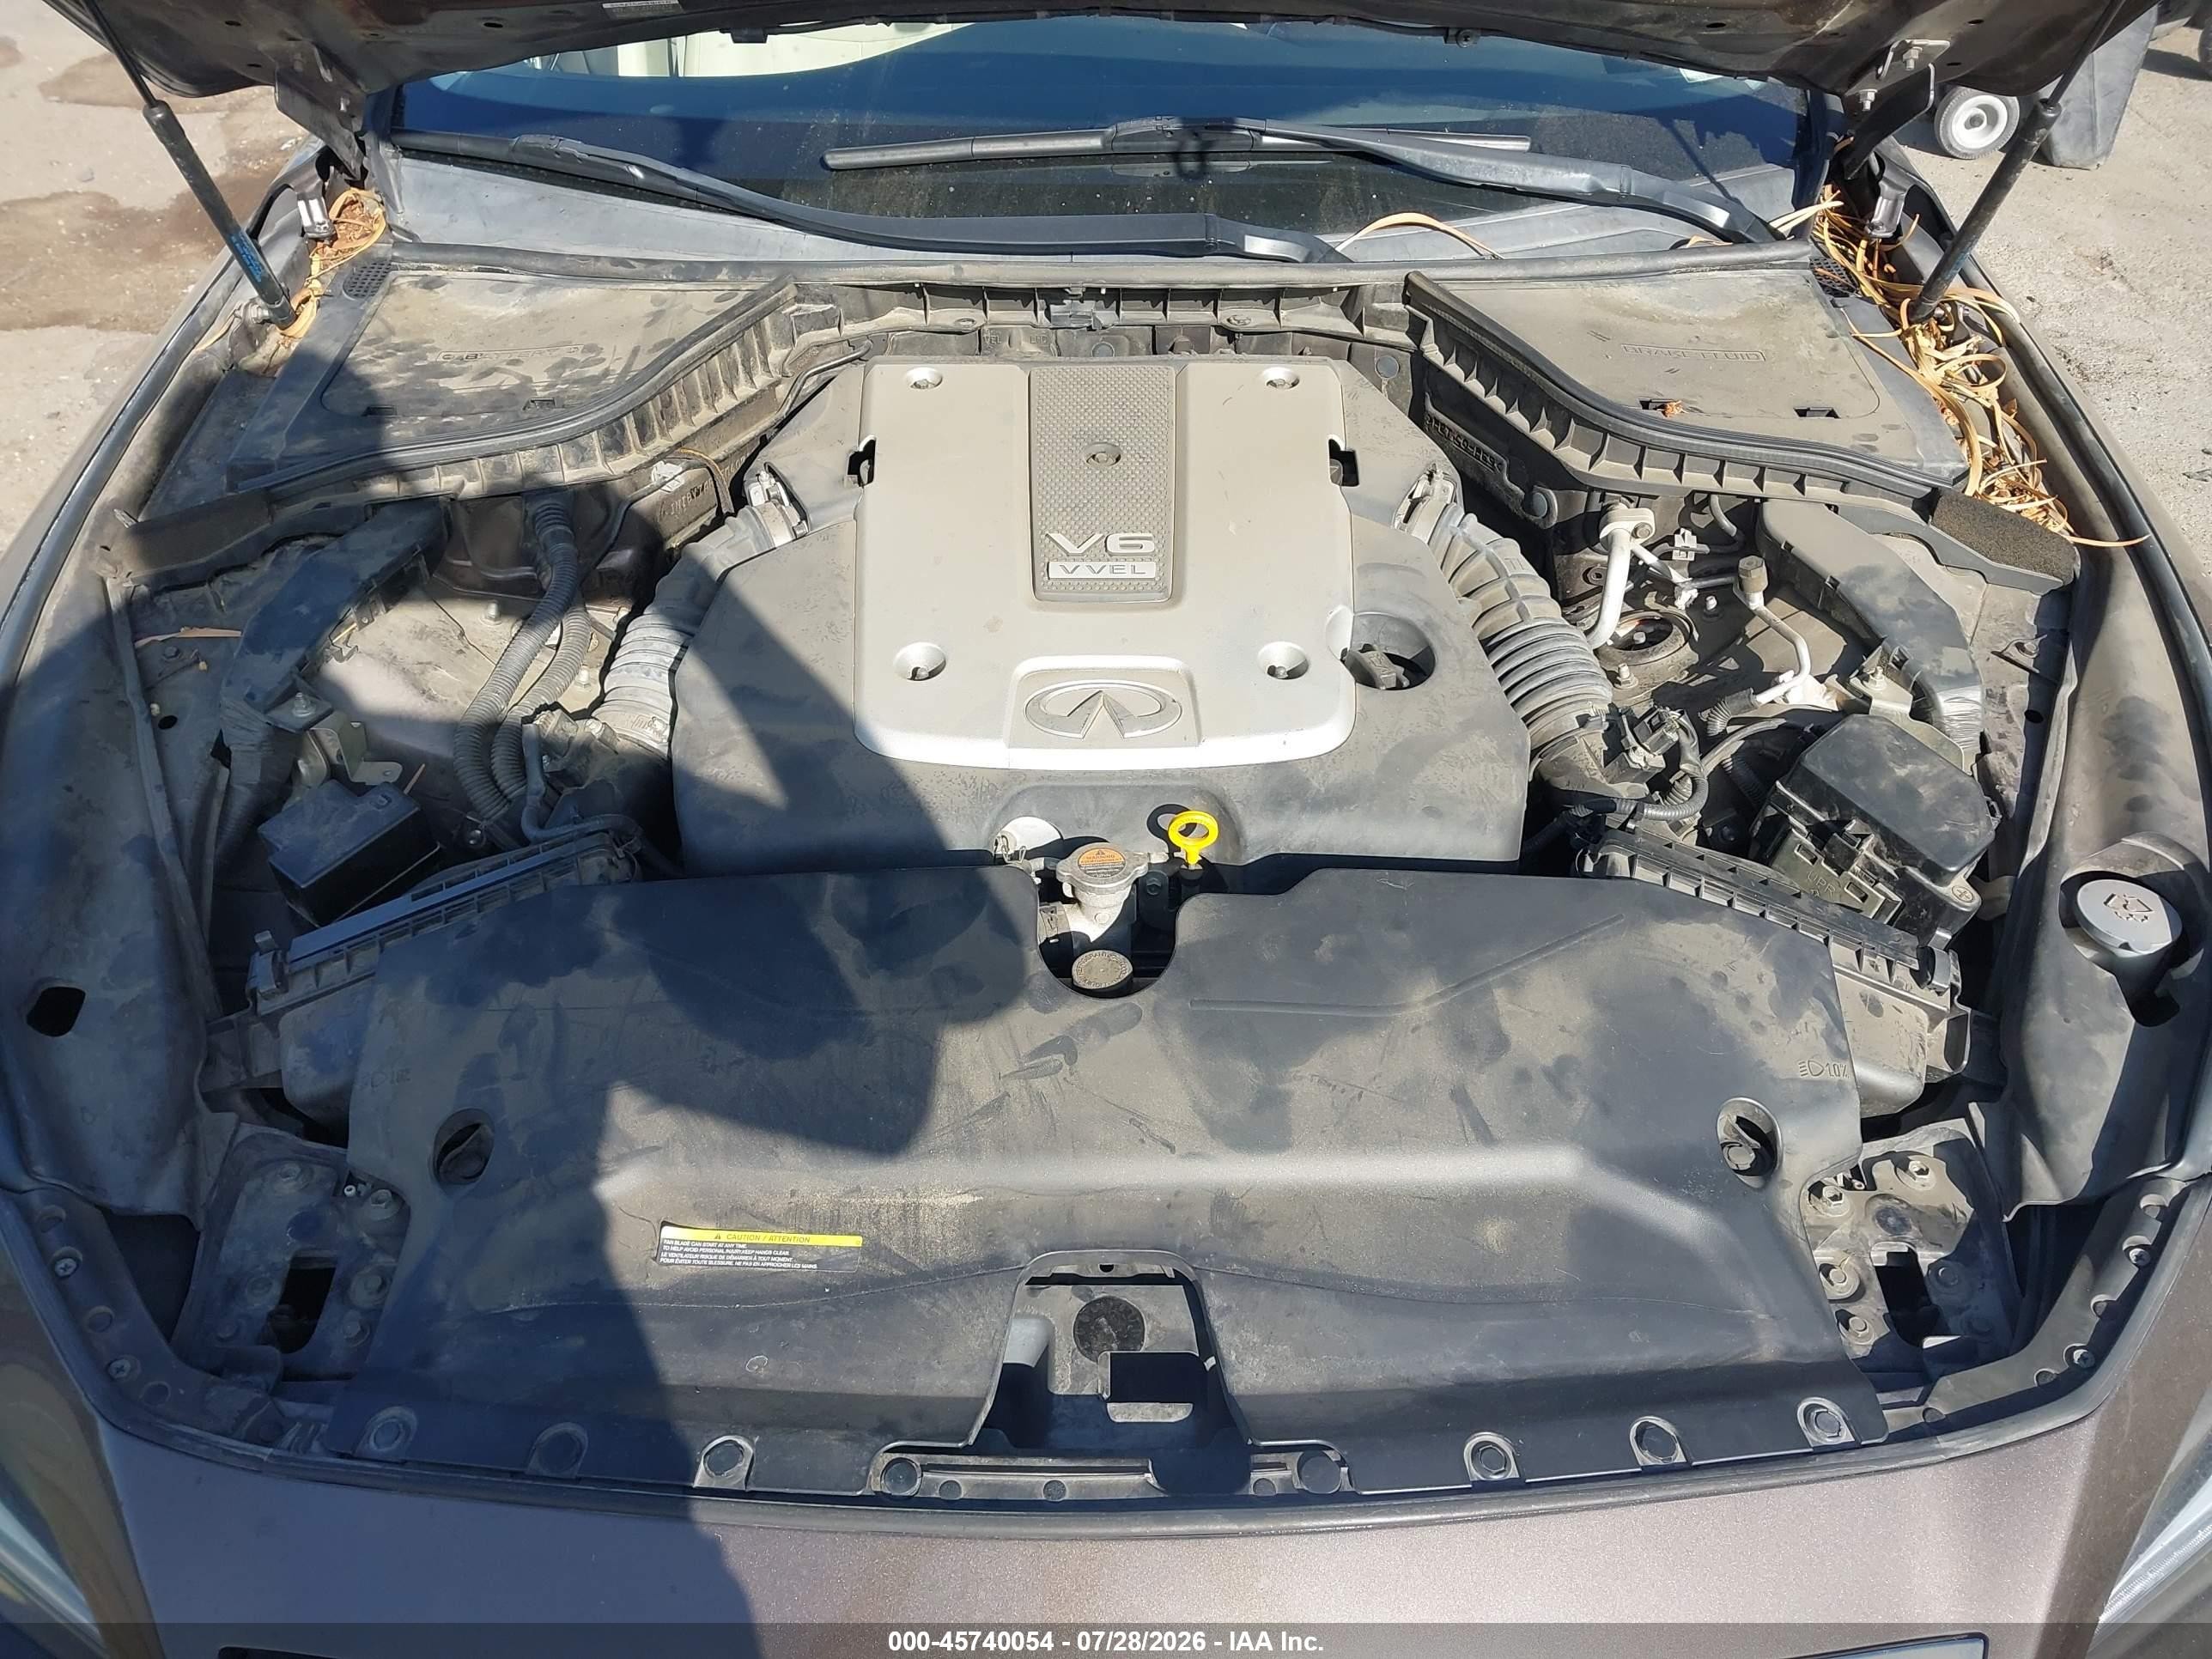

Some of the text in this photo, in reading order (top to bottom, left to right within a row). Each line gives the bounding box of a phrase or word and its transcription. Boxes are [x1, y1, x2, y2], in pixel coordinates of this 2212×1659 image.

[1045, 532, 1155, 556] V6
[1060, 564, 1146, 574] VVEL
[726, 1233, 761, 1242] CAUTION
[769, 1235, 811, 1244] ATTENTION
